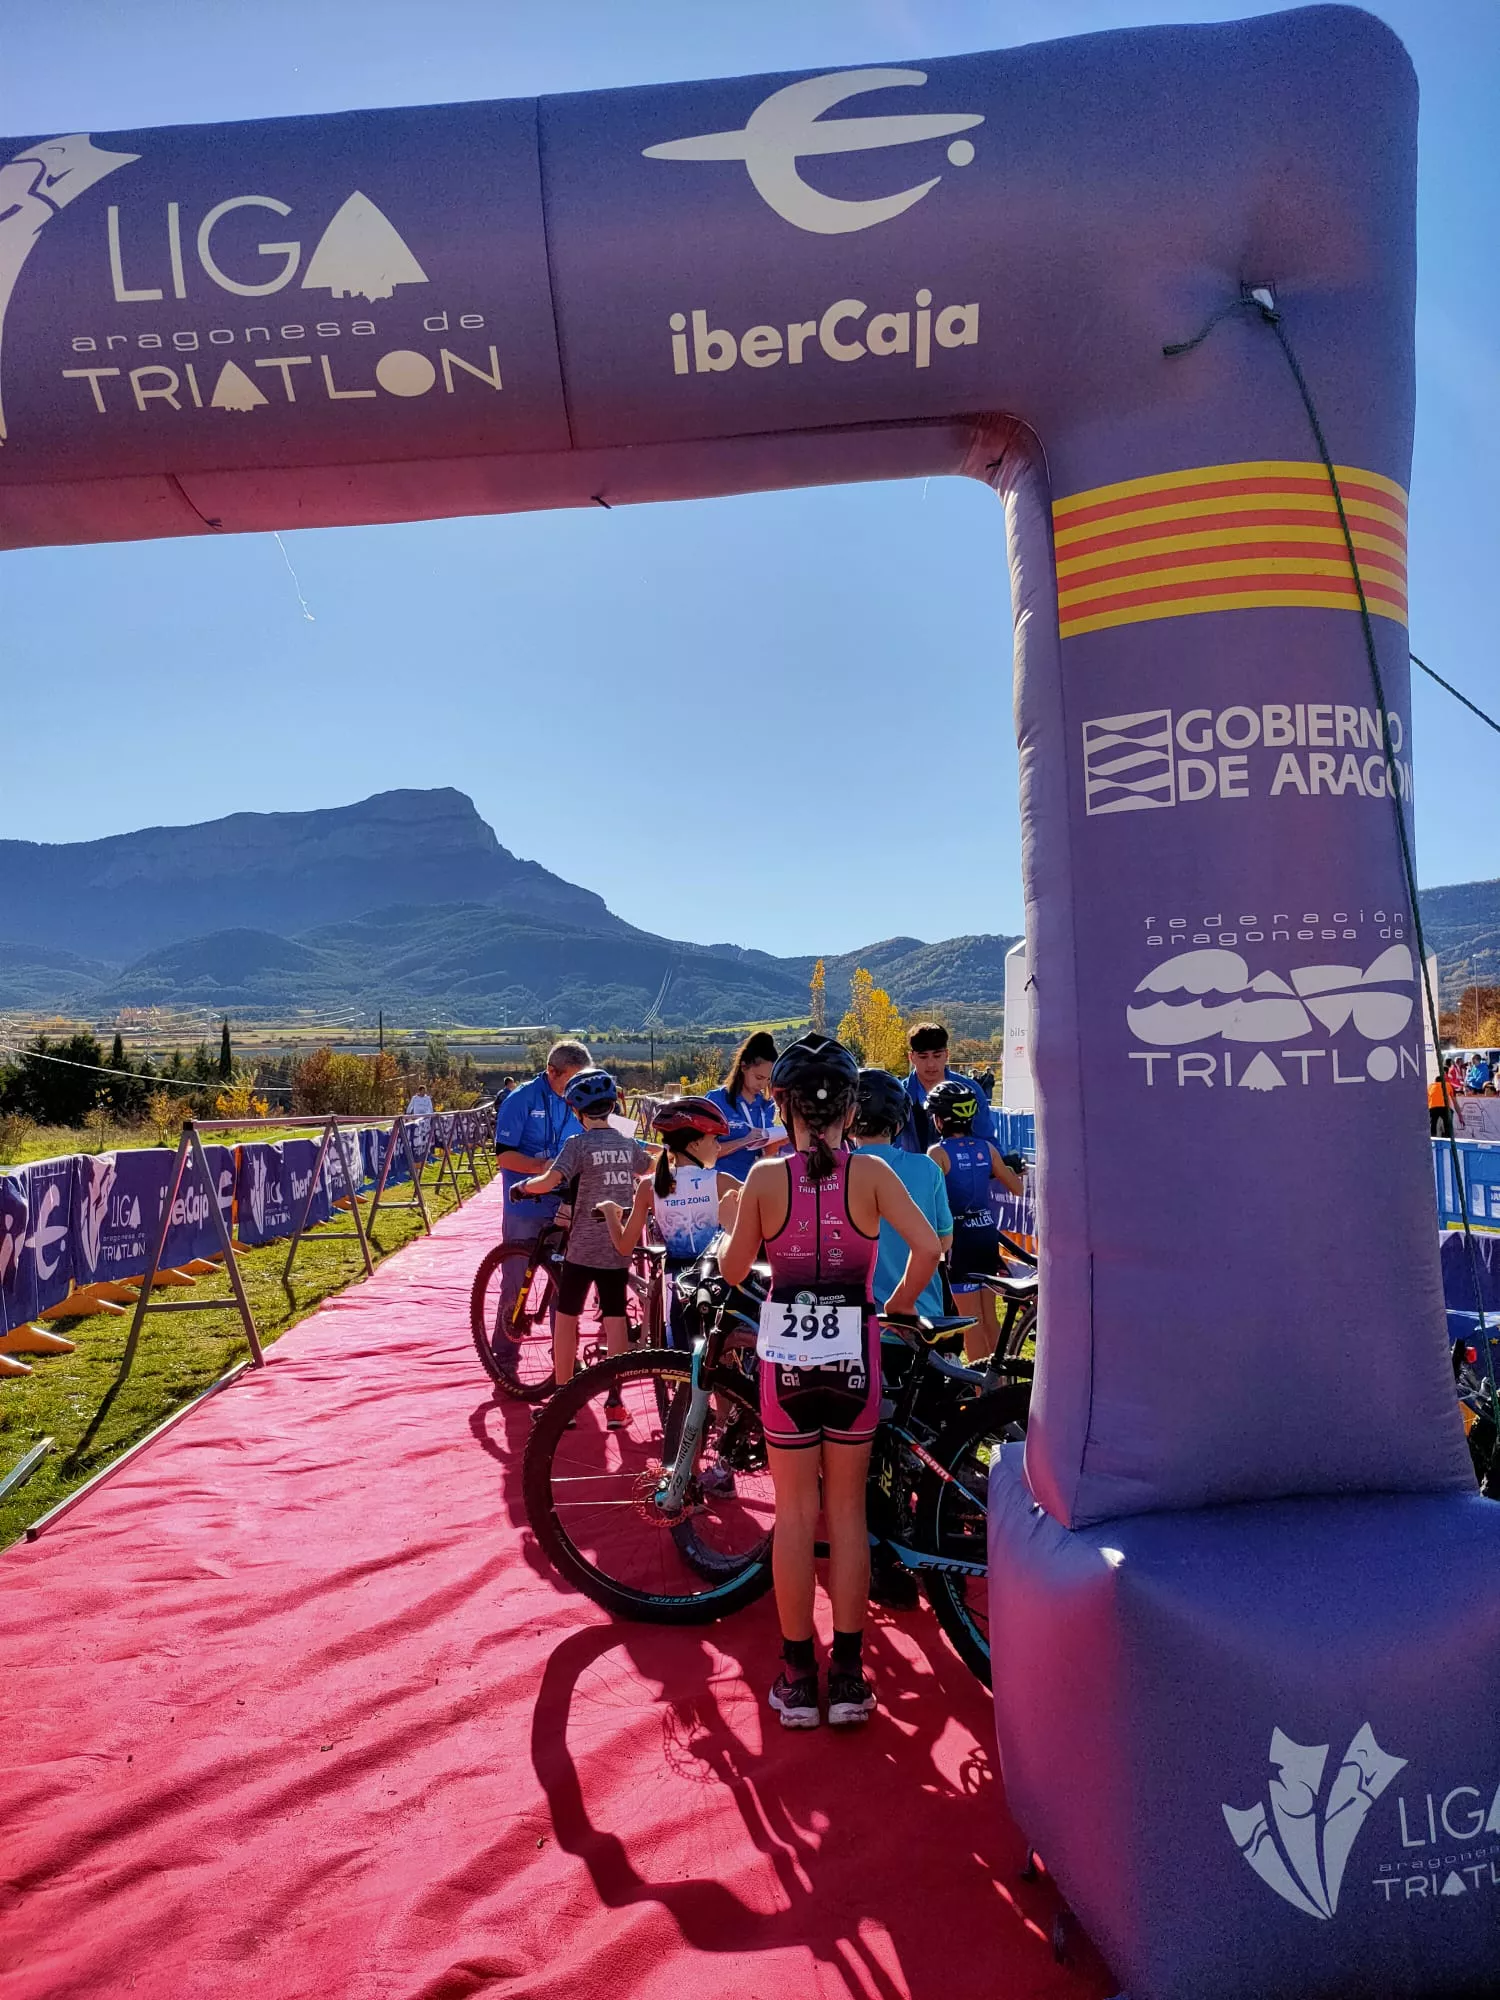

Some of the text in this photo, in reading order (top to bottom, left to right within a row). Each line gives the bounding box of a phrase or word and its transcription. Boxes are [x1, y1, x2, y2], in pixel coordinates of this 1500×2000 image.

[108, 190, 429, 303] LIGA
[72, 311, 485, 351] aragonesa de
[669, 289, 979, 375] iberCaja
[62, 346, 502, 413] TRIATLON
[1176, 704, 1403, 753] GOBIERNO
[1178, 755, 1249, 801] DE
[1144, 909, 1404, 929] federación
[1146, 926, 1404, 946] aragonesa de
[1128, 1043, 1420, 1092] TRIATLON
[111, 1195, 141, 1229] LIGA
[159, 1185, 209, 1231] ierCaja
[102, 1242, 146, 1261] TRIATLON
[780, 1313, 840, 1342] 298
